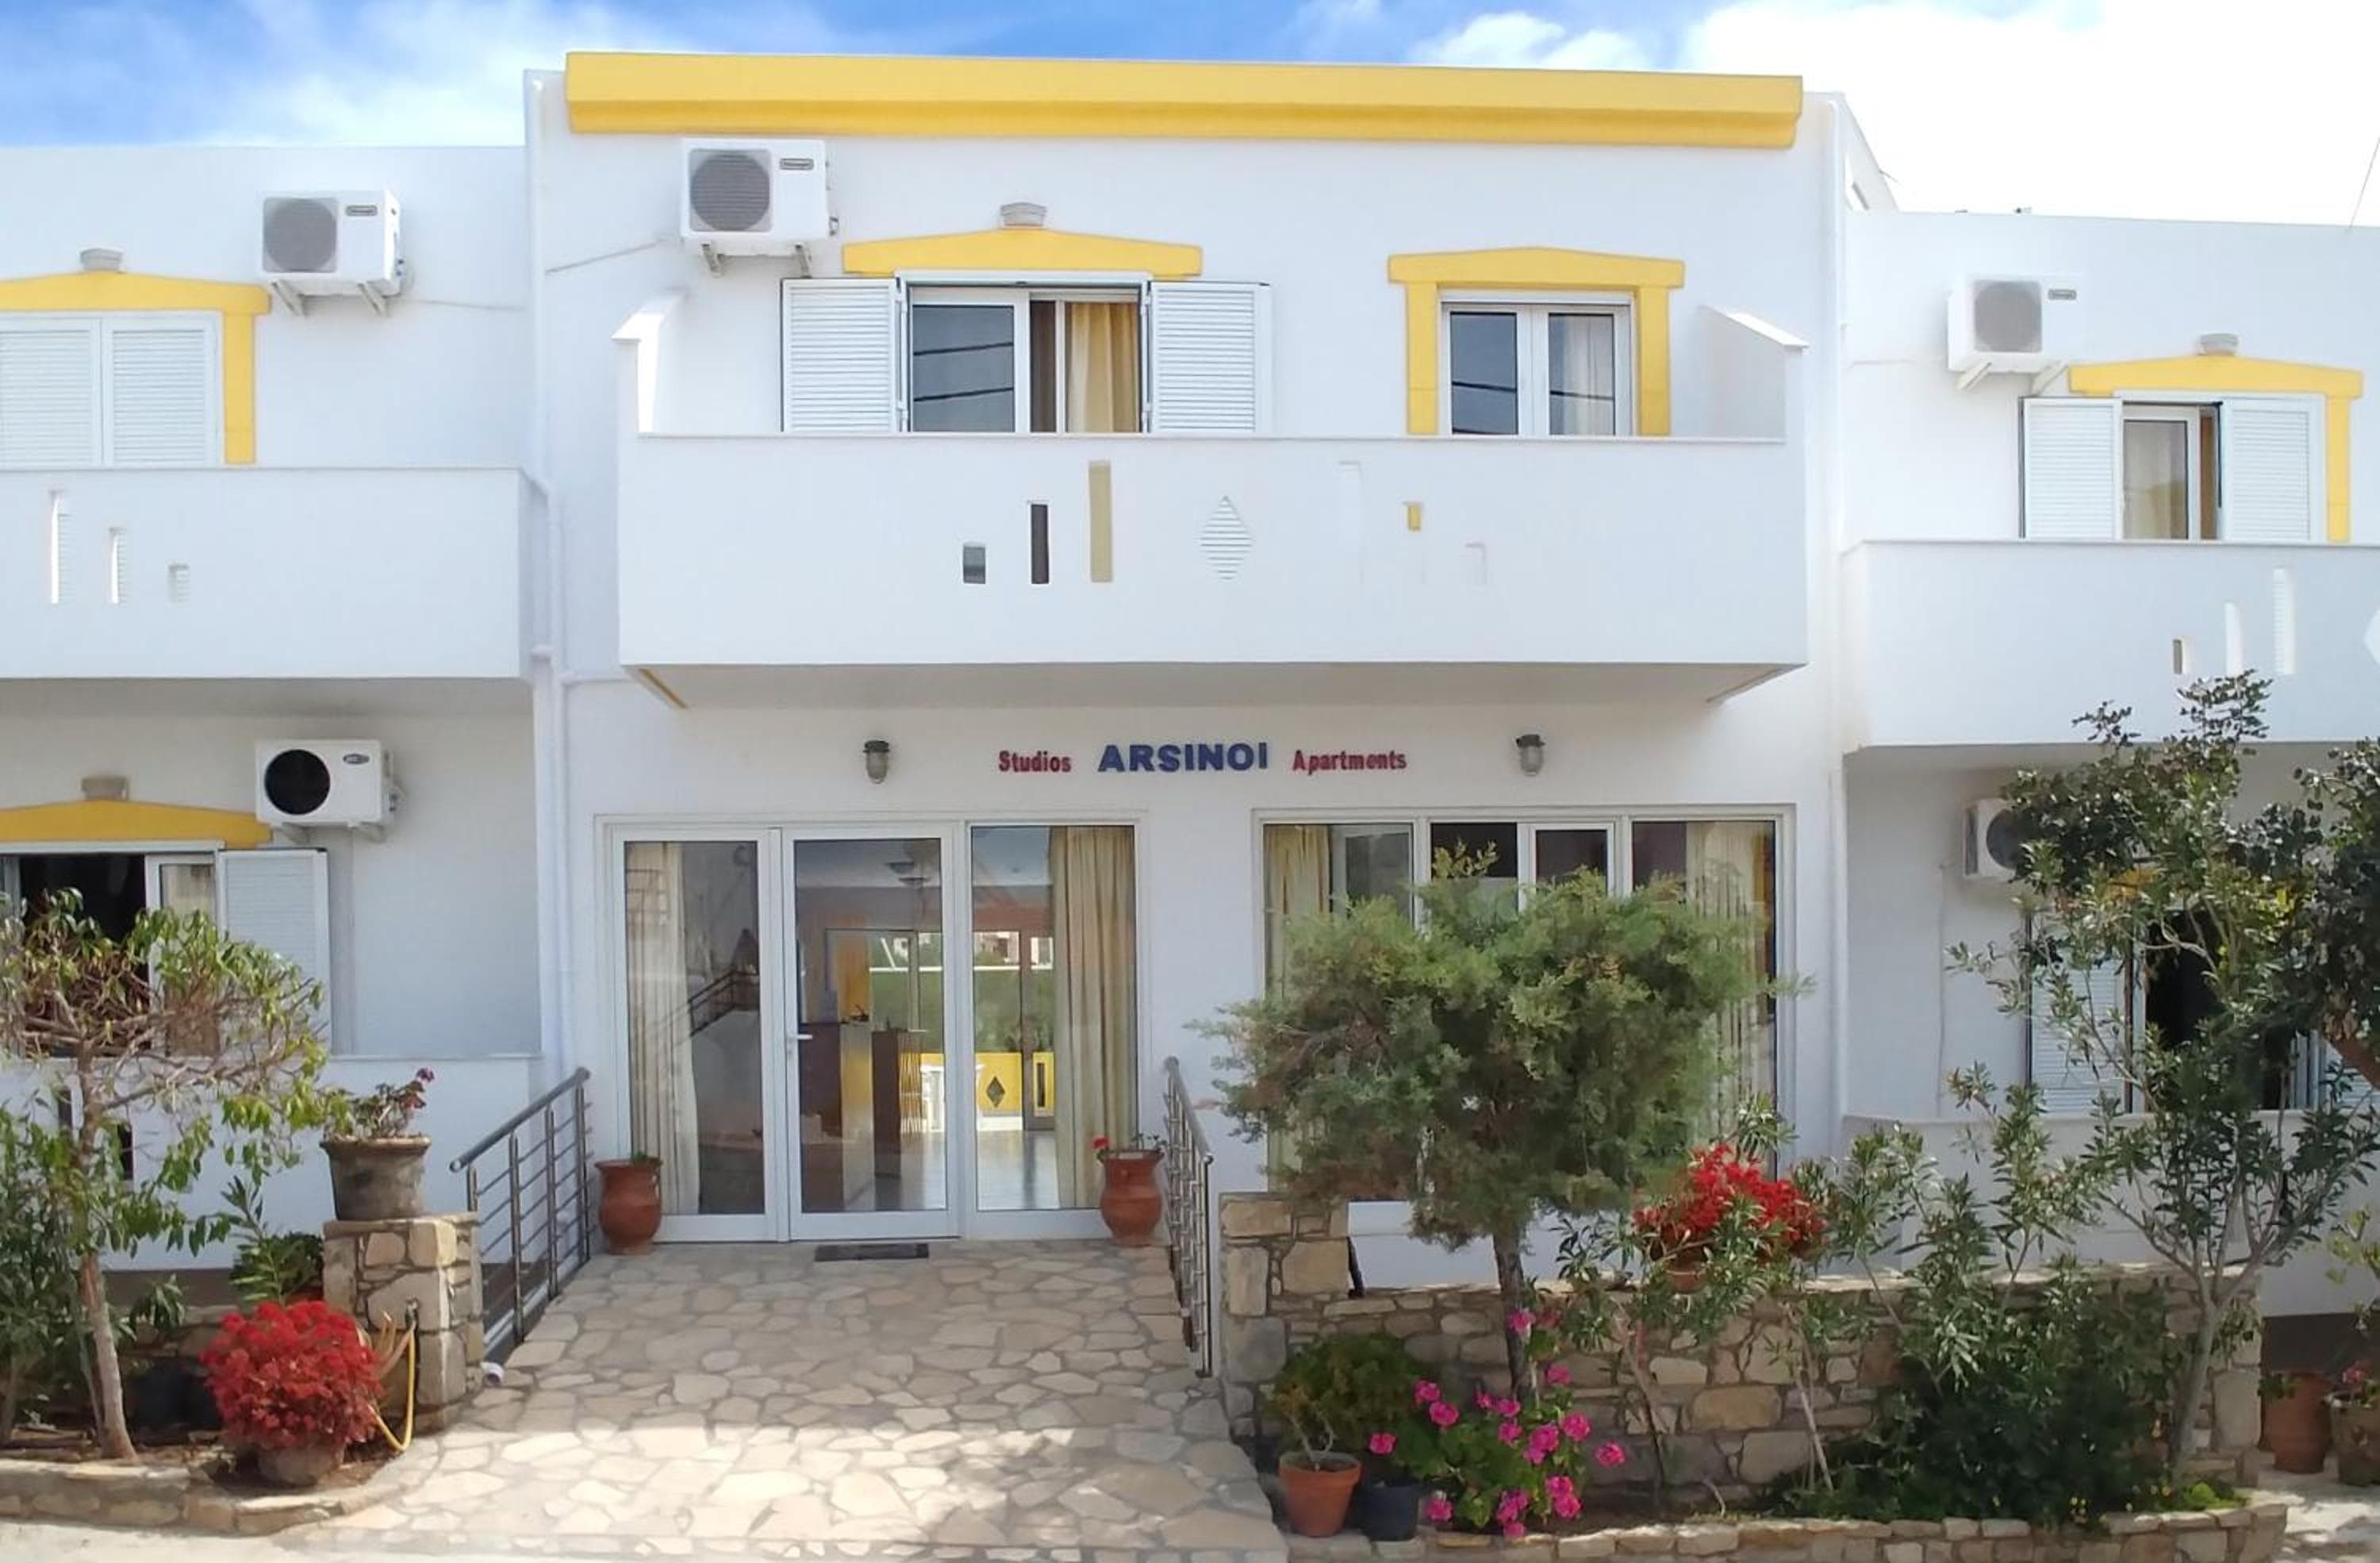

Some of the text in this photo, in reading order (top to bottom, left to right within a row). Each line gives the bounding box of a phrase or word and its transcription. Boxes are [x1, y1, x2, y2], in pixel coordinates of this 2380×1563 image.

[998, 742, 1407, 775] Studios ARSINOI Apartments
